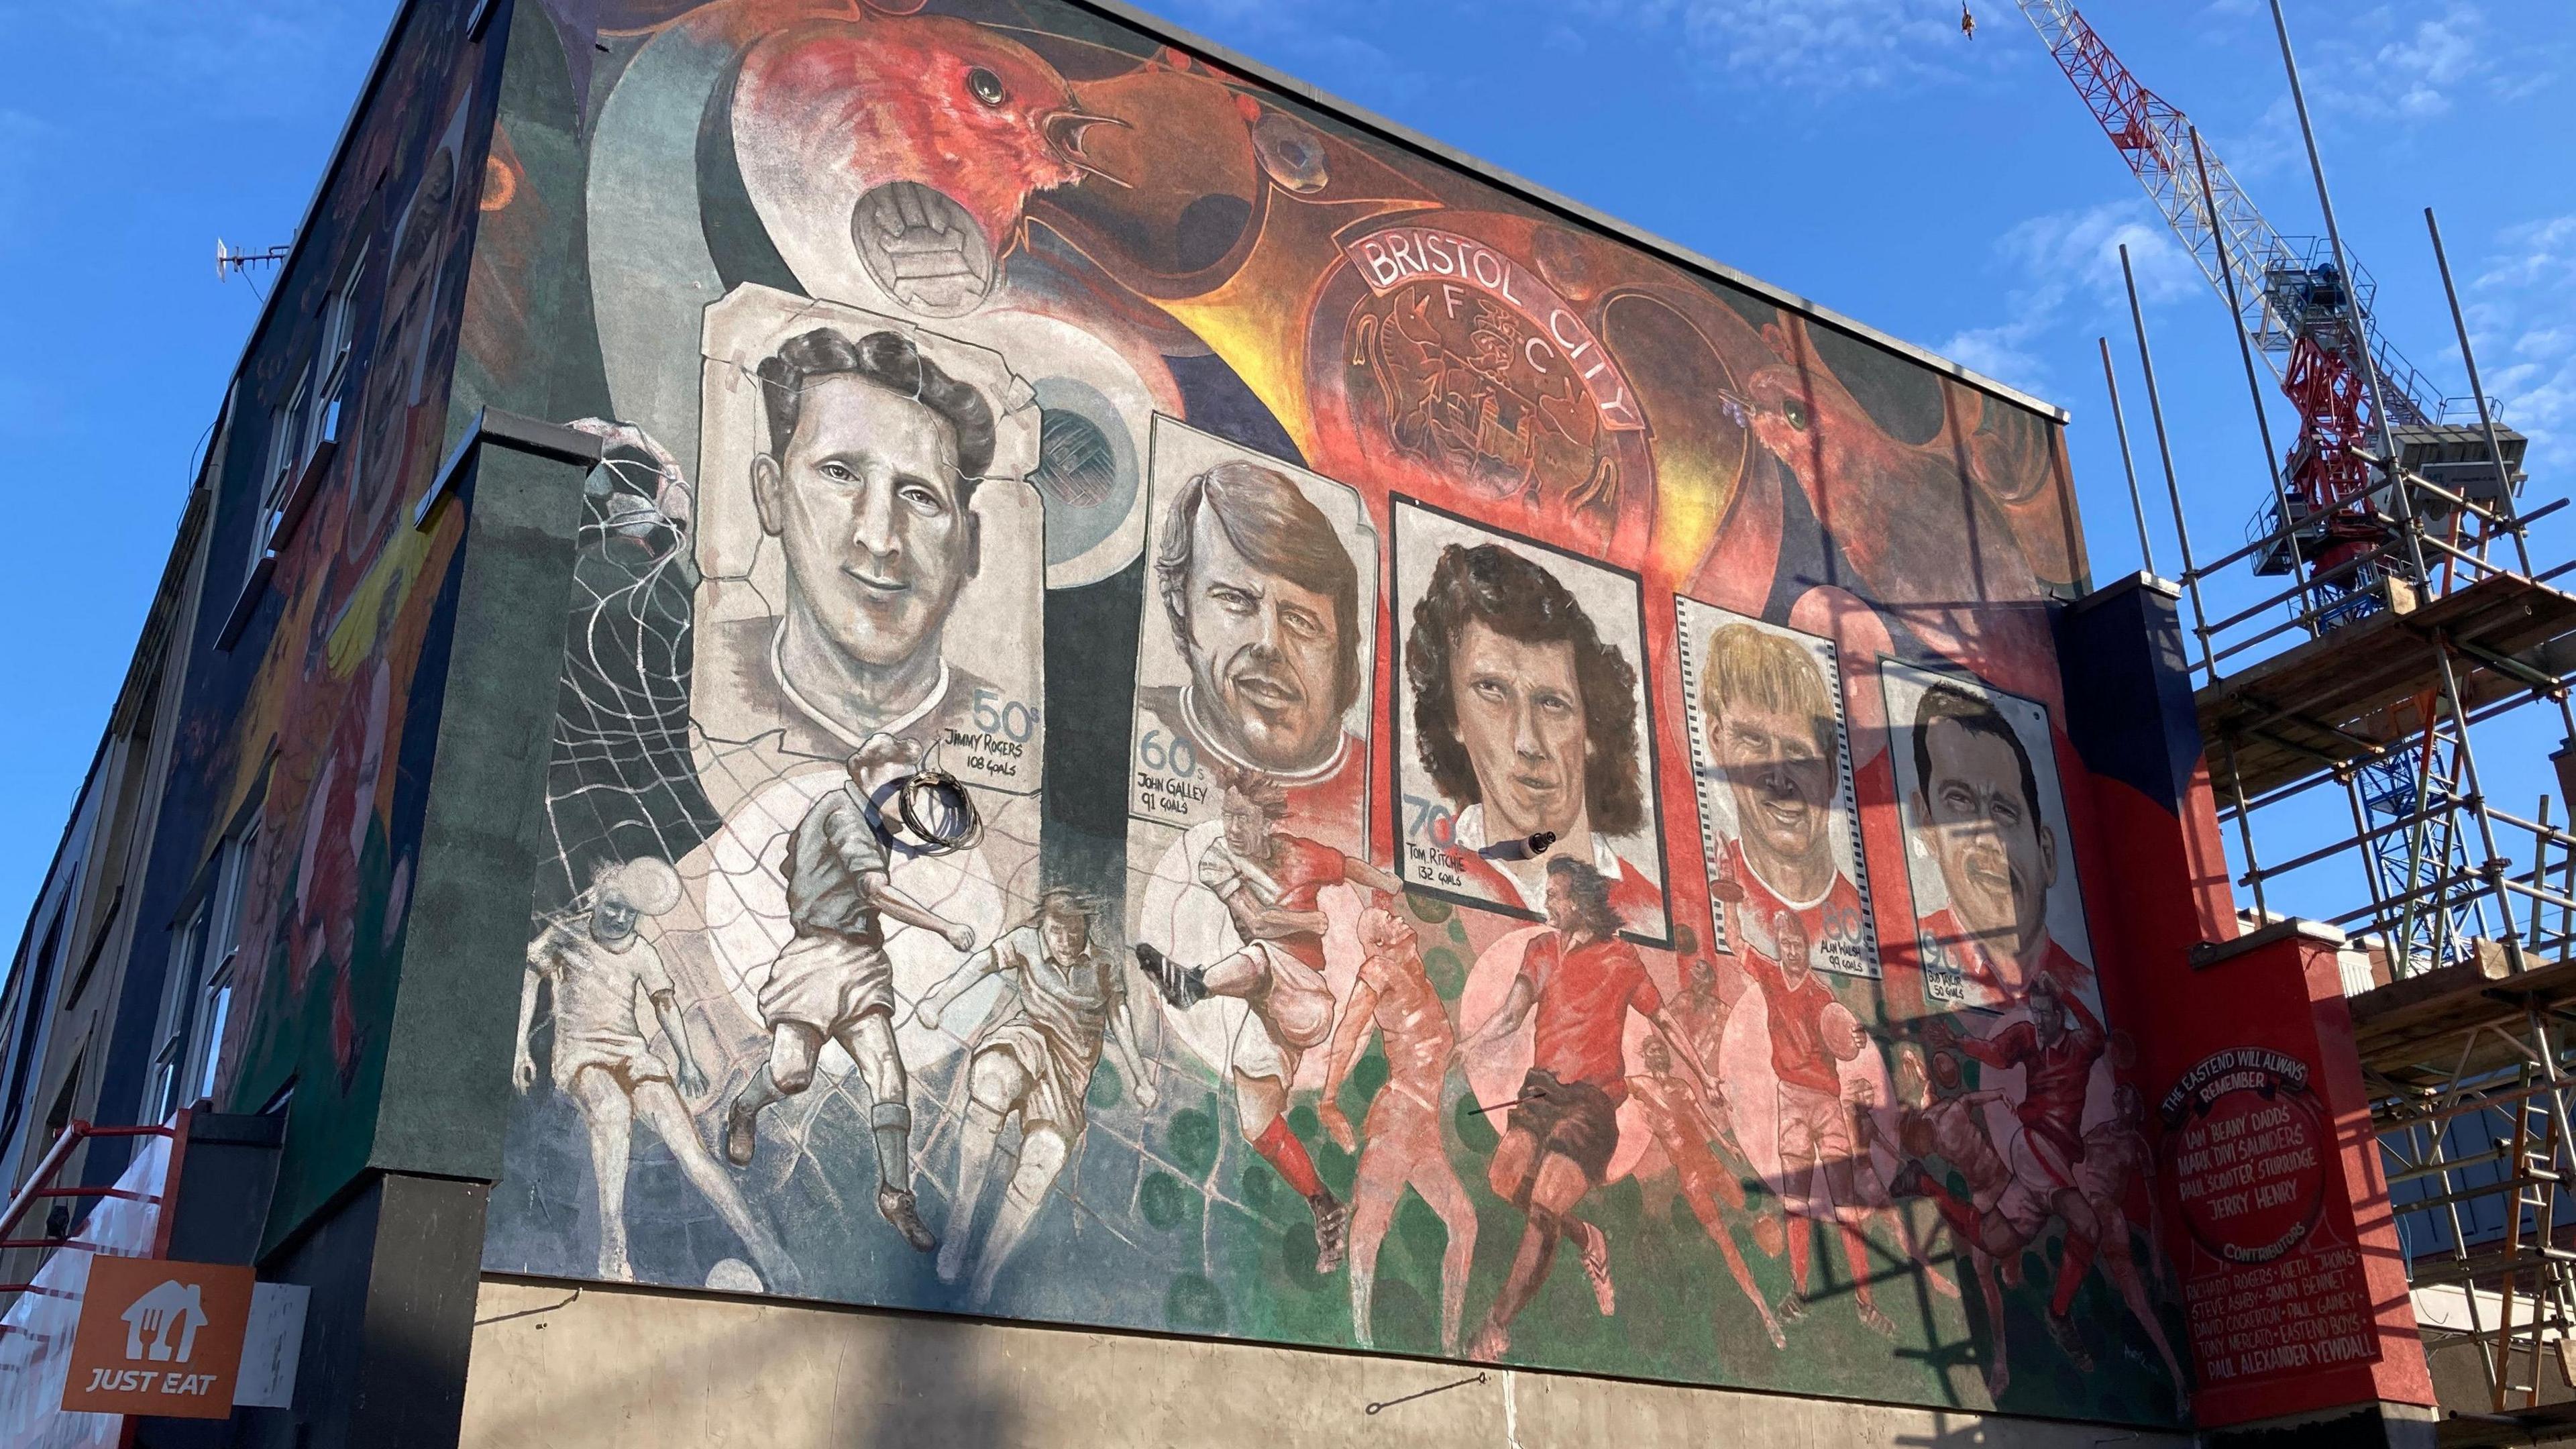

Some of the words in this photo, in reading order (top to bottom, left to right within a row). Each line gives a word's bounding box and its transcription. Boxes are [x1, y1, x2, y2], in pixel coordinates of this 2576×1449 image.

[1364, 232, 1522, 306] BRISTOL
[1549, 309, 1636, 419] CITY
[967, 755, 985, 769] 108
[983, 734, 1023, 758] ROGERS
[1138, 772, 1164, 792] JOHN
[1166, 778, 1208, 804] GALLEY
[1142, 792, 1156, 811] 91
[1160, 797, 1188, 814] GOALS
[1418, 866, 1434, 880] 132
[1438, 872, 1462, 887] GOALS
[1821, 939, 1837, 954] ALAN
[1837, 941, 1862, 959] WALSH
[1829, 955, 1841, 969] 99
[1842, 960, 1863, 972] GOALS
[2162, 1087, 2185, 1112] THE
[2237, 1051, 2260, 1067] WILL
[2263, 1053, 2306, 1081] ALWAYS
[2199, 1071, 2264, 1103] REMEMBER
[2186, 1128, 2206, 1149] IAN
[2251, 1104, 2290, 1131] DADDS
[2178, 1148, 2212, 1176] MARK
[2238, 1122, 2304, 1160] SAUNDERS
[2180, 1178, 2206, 1201] PAUL
[2258, 1146, 2318, 1179] STURRIDGE
[2206, 1190, 2249, 1220] JERRY
[2254, 1177, 2298, 1209] HENRY
[2223, 1222, 2306, 1261] CONTRIBUTORS
[2186, 1277, 2231, 1302] RICHARD
[2191, 1297, 2226, 1320] STEVE
[2265, 1281, 2298, 1303] SIMON
[2194, 1318, 2224, 1339] DAVID
[2287, 1301, 2314, 1320] PAUL
[2197, 1337, 2224, 1358] TONY
[2329, 1312, 2361, 1335] BOYS
[2207, 1357, 2237, 1381] PAUL
[2241, 1343, 2312, 1375] ALEXANDER
[2310, 1333, 2377, 1364] YEWDALL
[86, 1368, 158, 1393] JUST
[161, 1373, 217, 1395] EAT
